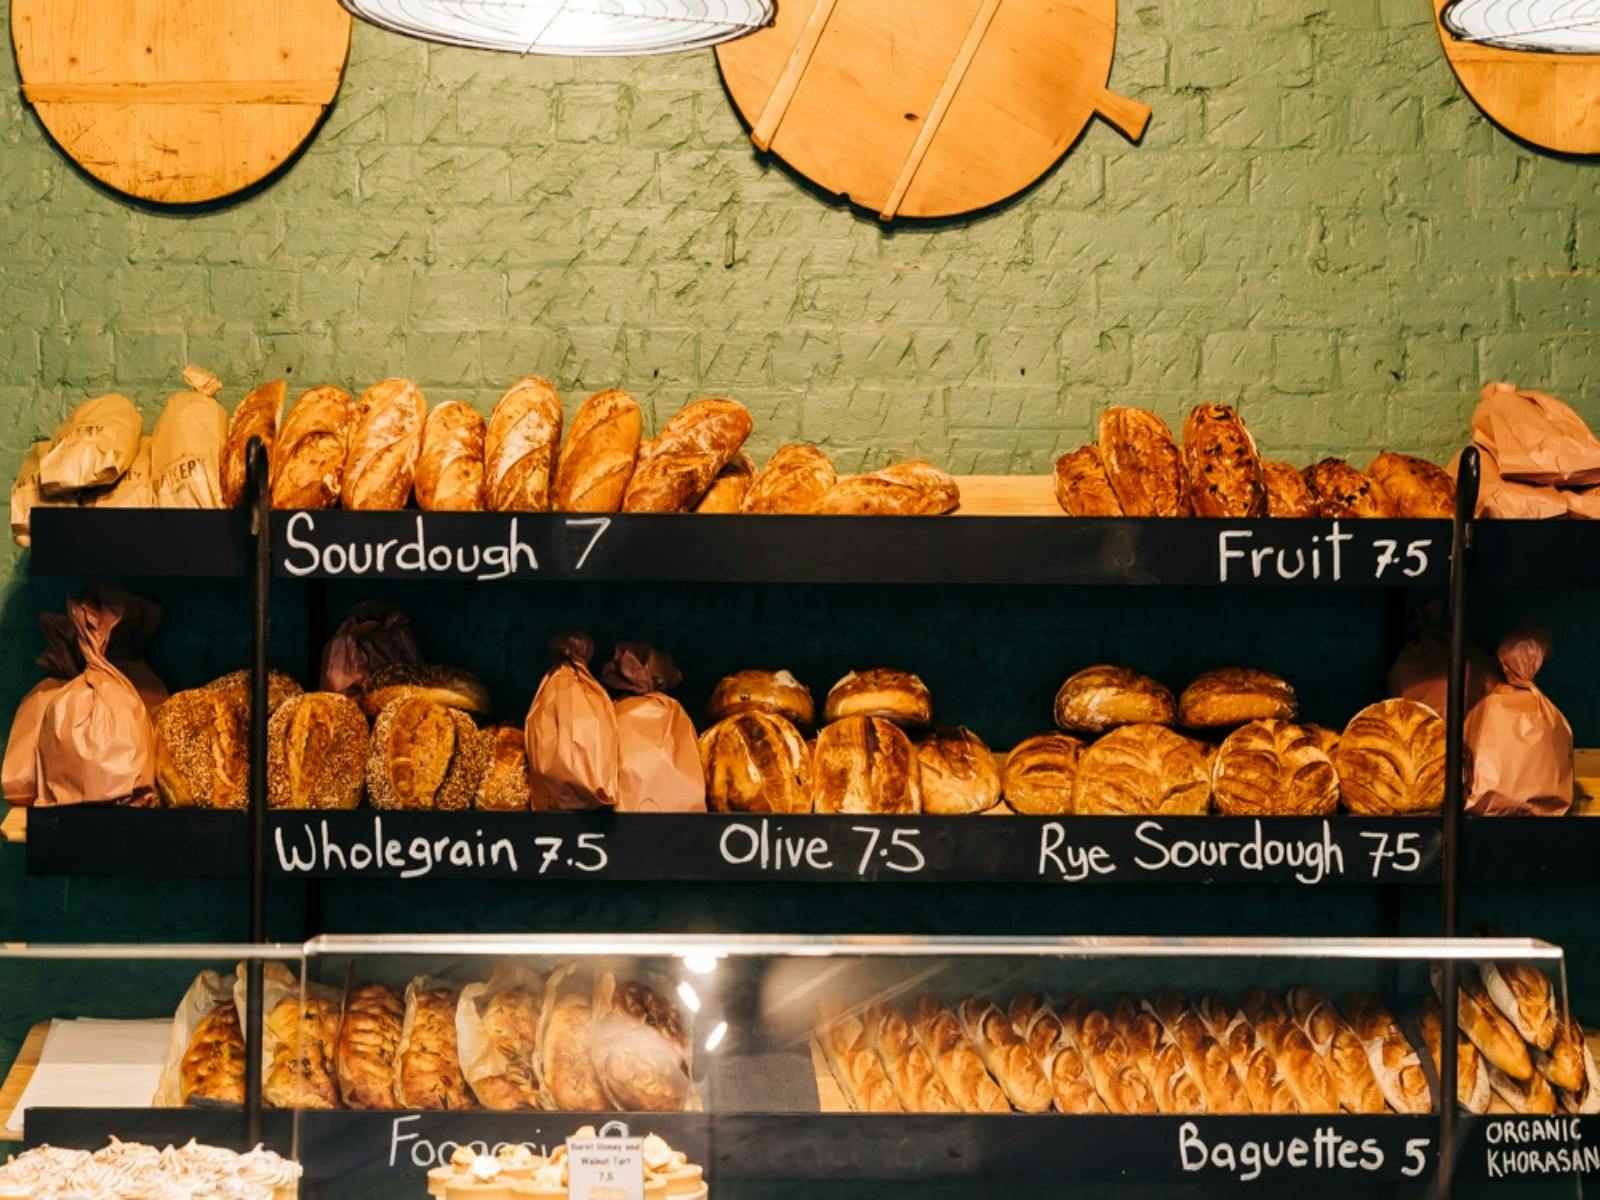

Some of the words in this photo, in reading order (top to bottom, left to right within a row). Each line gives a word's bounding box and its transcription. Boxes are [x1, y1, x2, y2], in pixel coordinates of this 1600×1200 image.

[284, 511, 539, 580] Sourdough
[565, 518, 611, 569] 7
[1219, 521, 1354, 582] Fruit
[275, 816, 518, 878] Wholegrain
[534, 833, 608, 873] 7.5
[719, 818, 833, 870] Olive
[852, 826, 926, 875] 7.5
[1038, 821, 1117, 881] Rye
[1134, 819, 1344, 884] Sourdough
[625, 1142, 640, 1151] and
[1179, 1121, 1385, 1181] Baguettes
[1401, 1138, 1431, 1177] 5
[1486, 1118, 1582, 1144] ORGANIC
[1487, 1146, 1600, 1177] KHORASAN
